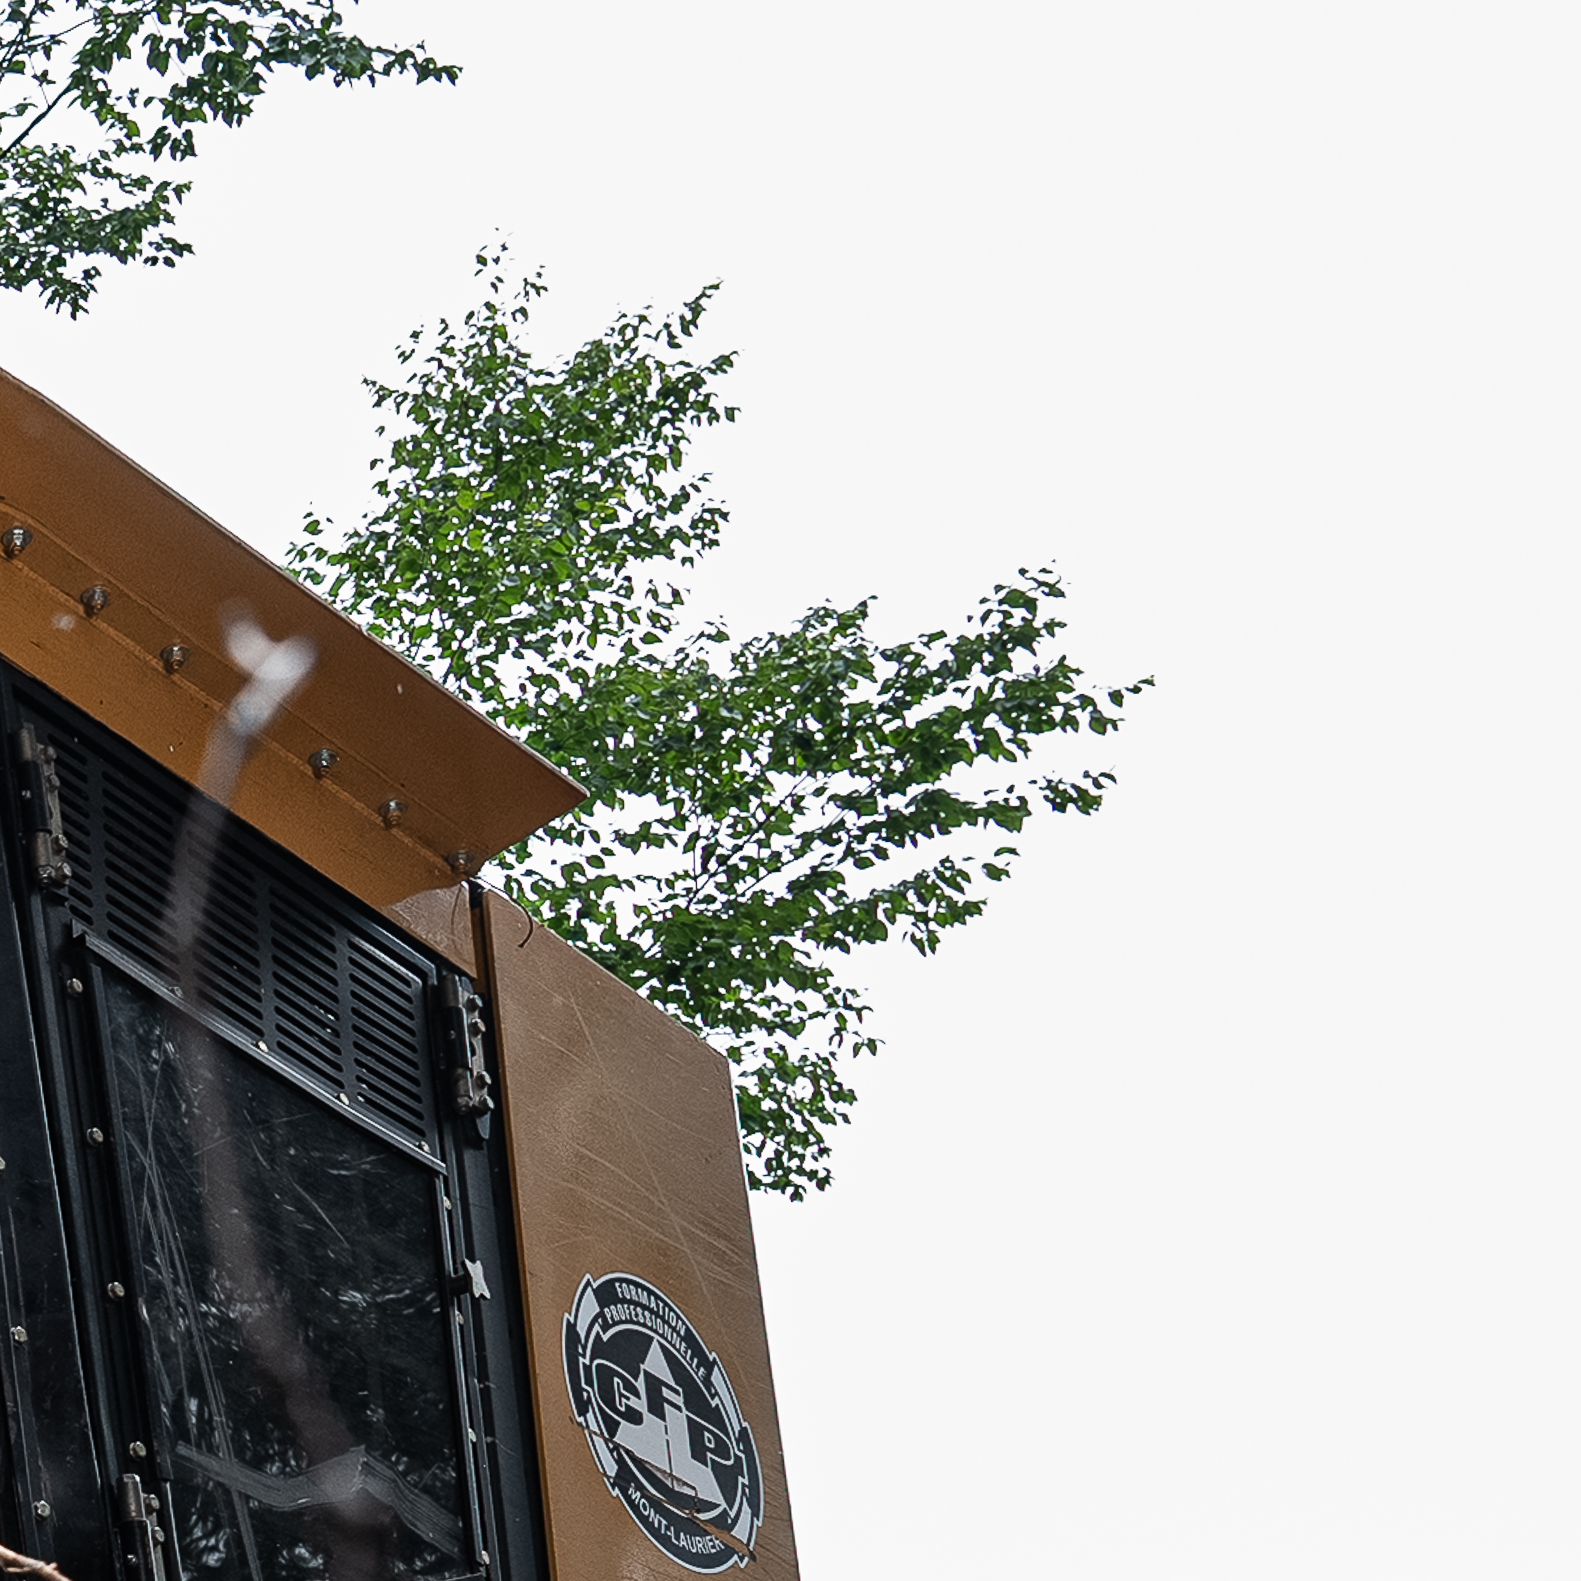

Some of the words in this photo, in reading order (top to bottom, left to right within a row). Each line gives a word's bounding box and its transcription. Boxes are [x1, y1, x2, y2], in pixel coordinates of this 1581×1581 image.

[603, 1303, 707, 1381] PROFESSIONNELLE
[615, 1282, 686, 1337] FORMATION
[593, 1360, 735, 1470] CFP
[628, 1484, 725, 1554] MONT-LAURIER
